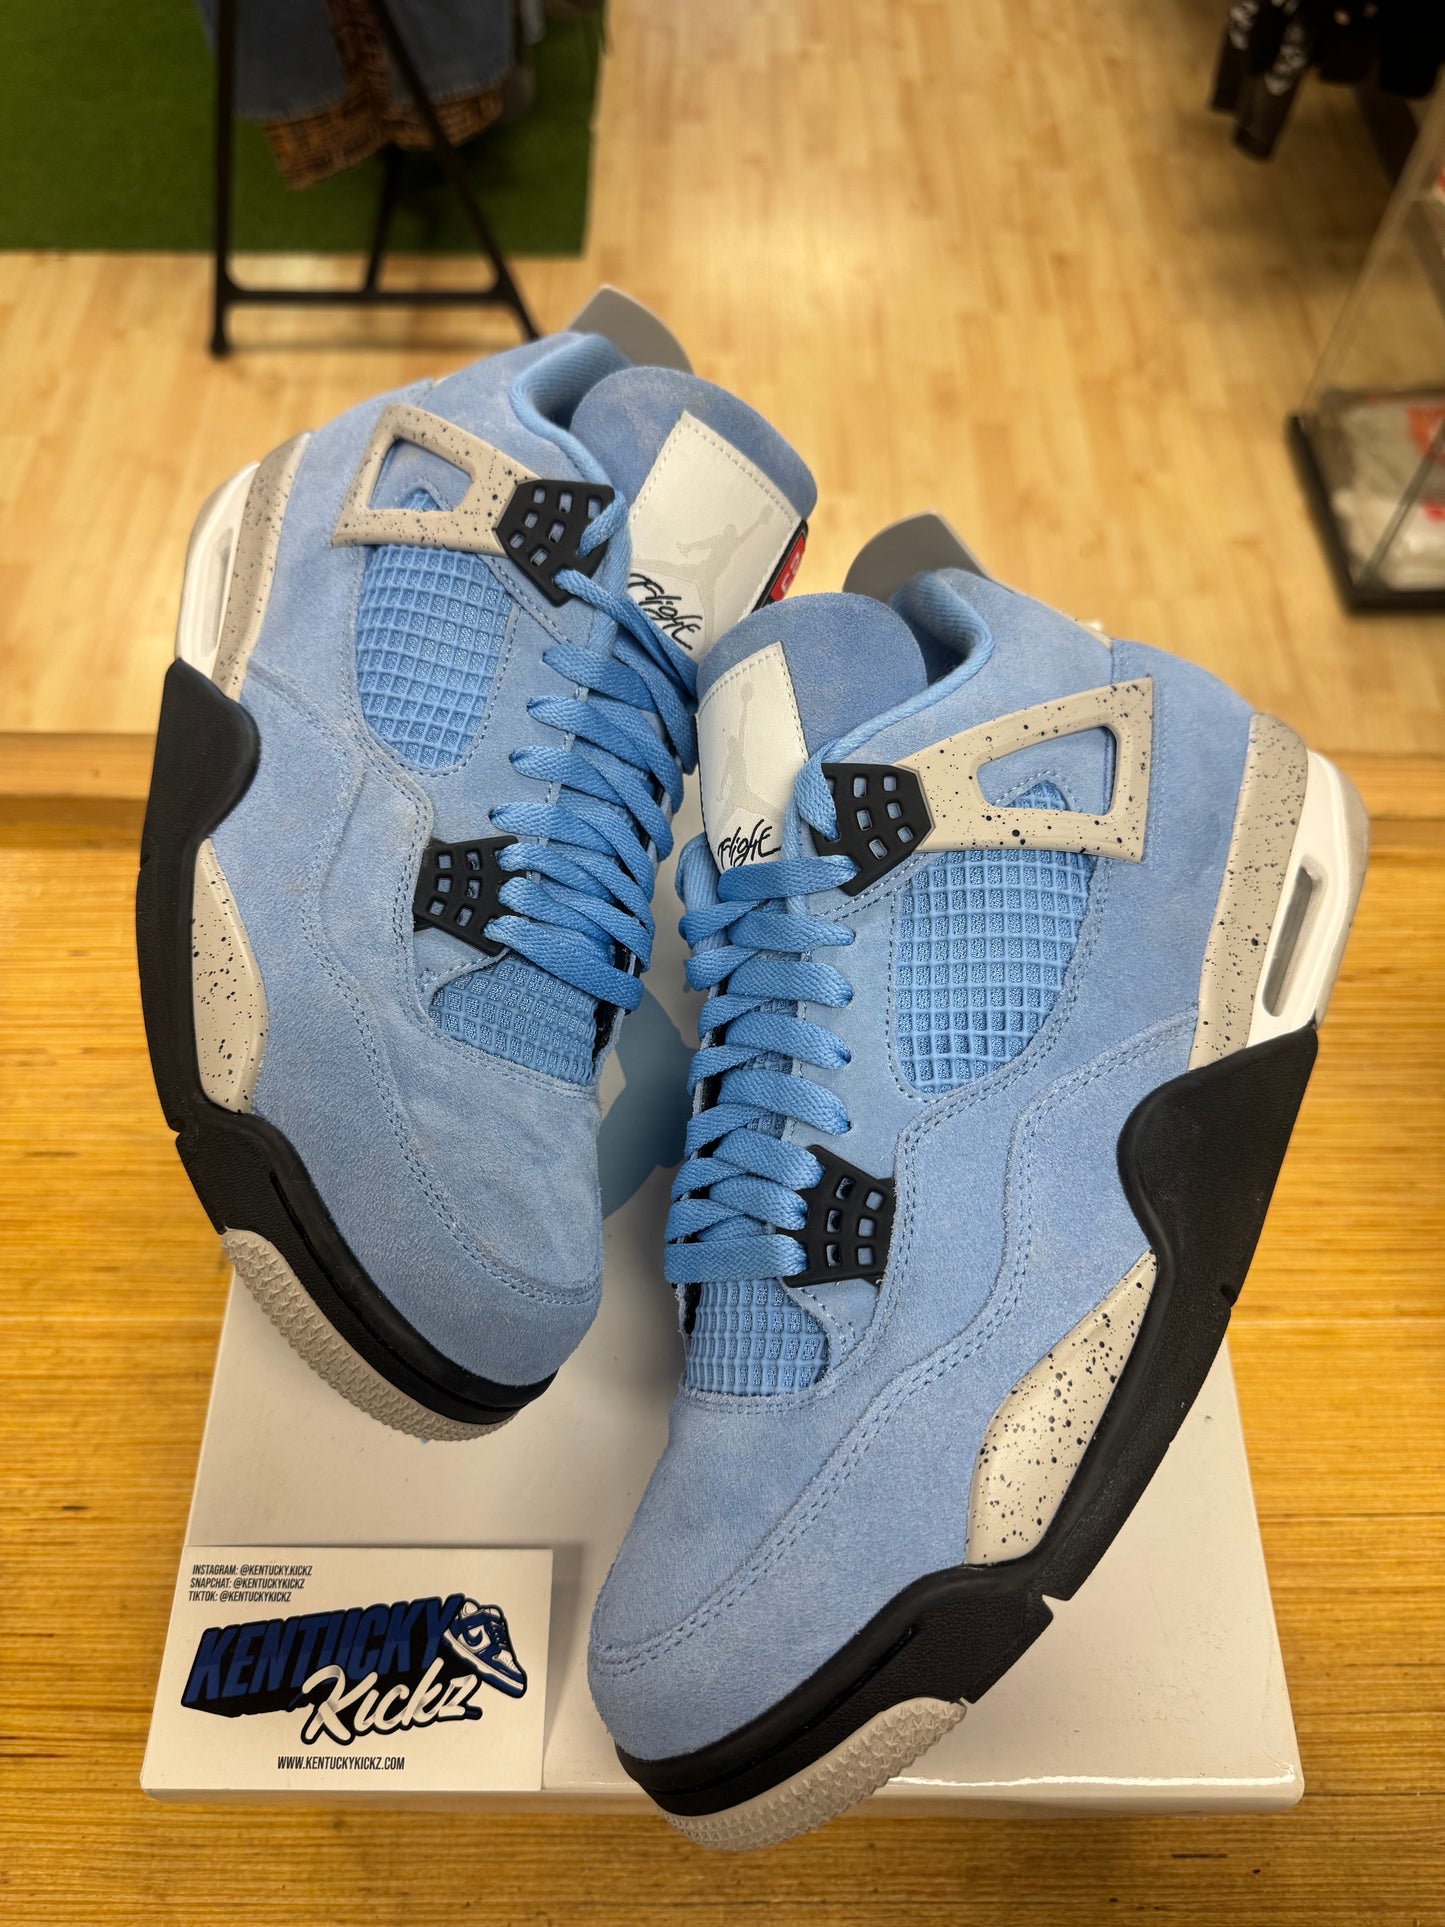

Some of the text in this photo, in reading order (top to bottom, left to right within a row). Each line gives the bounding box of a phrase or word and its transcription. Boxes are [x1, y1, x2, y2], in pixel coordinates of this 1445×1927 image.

[192, 1564, 313, 1576] INSTAGRAM: @KENTUCKY.KICKZ
[190, 1577, 305, 1589] SNAPCHAT: @KENTUCKYKICKZ
[188, 1590, 292, 1602] TIKTOK: @KENTUCKYKICKZ
[182, 1593, 466, 1709] KENTUCKY
[301, 1657, 480, 1744] Kickz
[277, 1756, 405, 1771] WWW.KENTUCKYKICKZ.COM
